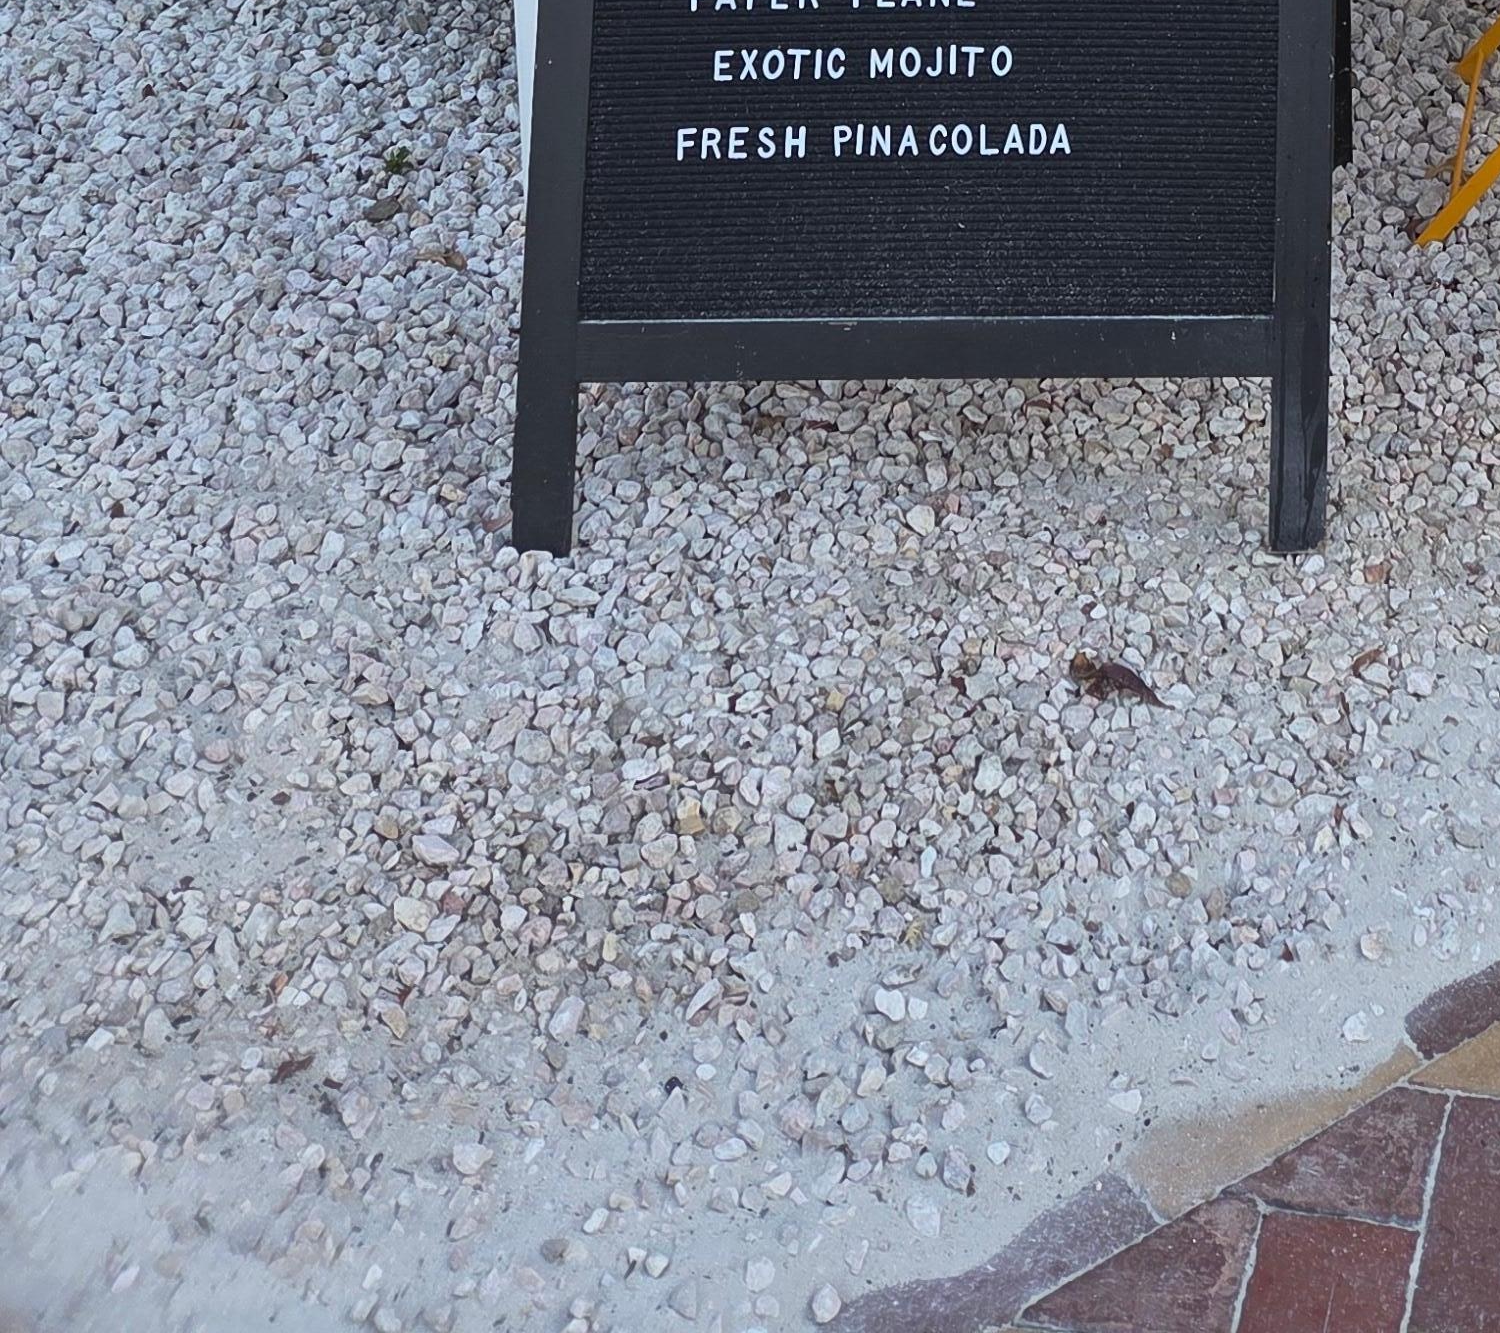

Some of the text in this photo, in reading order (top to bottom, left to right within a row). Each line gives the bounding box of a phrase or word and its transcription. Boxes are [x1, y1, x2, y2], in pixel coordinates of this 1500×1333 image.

[713, 45, 1013, 82] EXOTIC MOJITO
[676, 126, 807, 161] FRESH
